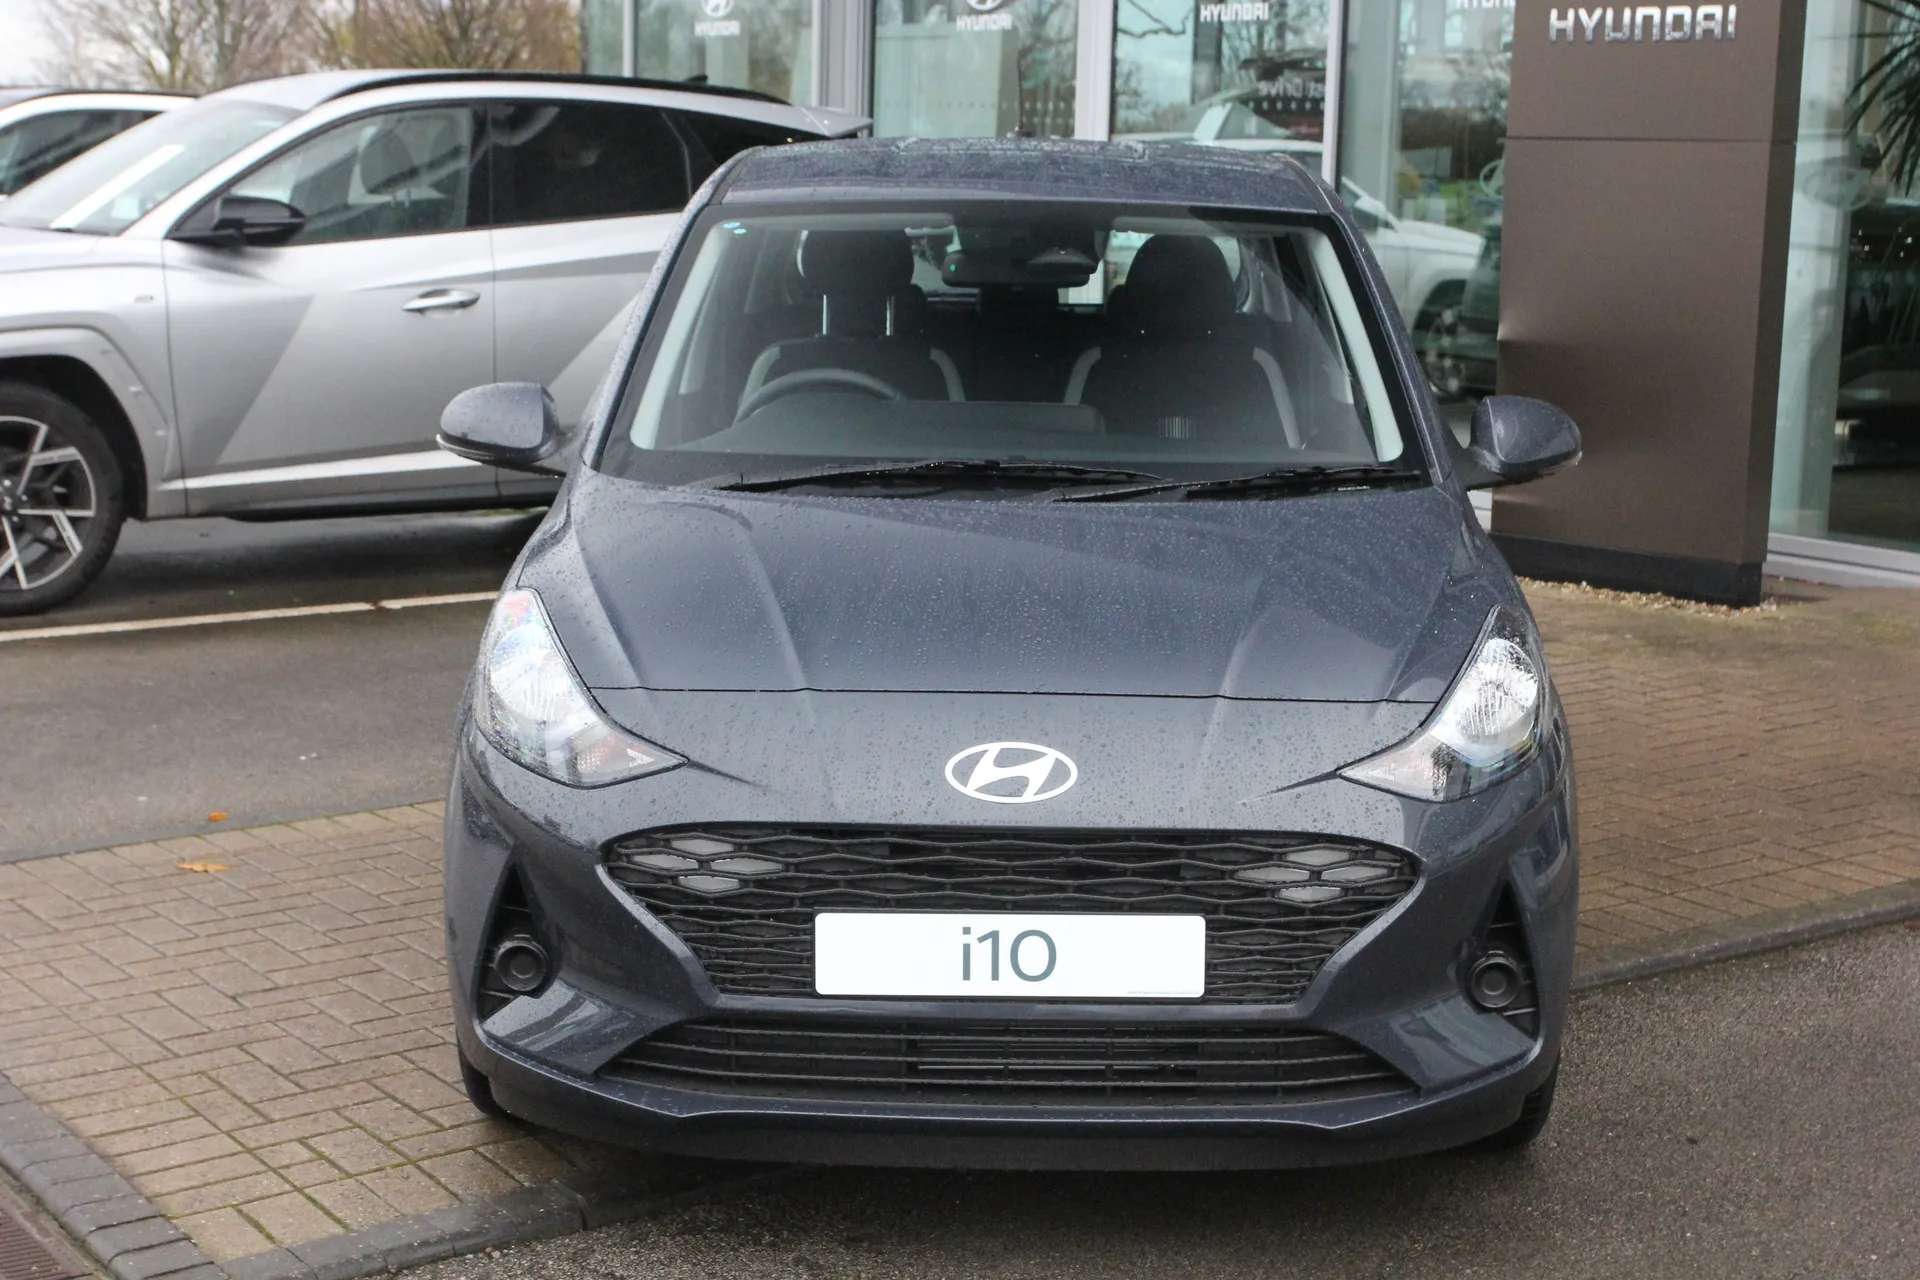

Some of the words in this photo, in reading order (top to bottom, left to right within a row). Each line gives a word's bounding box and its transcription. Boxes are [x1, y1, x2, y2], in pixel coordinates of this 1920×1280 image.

[956, 14, 1012, 32] HYUNDAI
[1200, 3, 1269, 22] HYUNDAI
[1549, 4, 1737, 42] HYUNDAI
[962, 926, 1057, 982] i10
